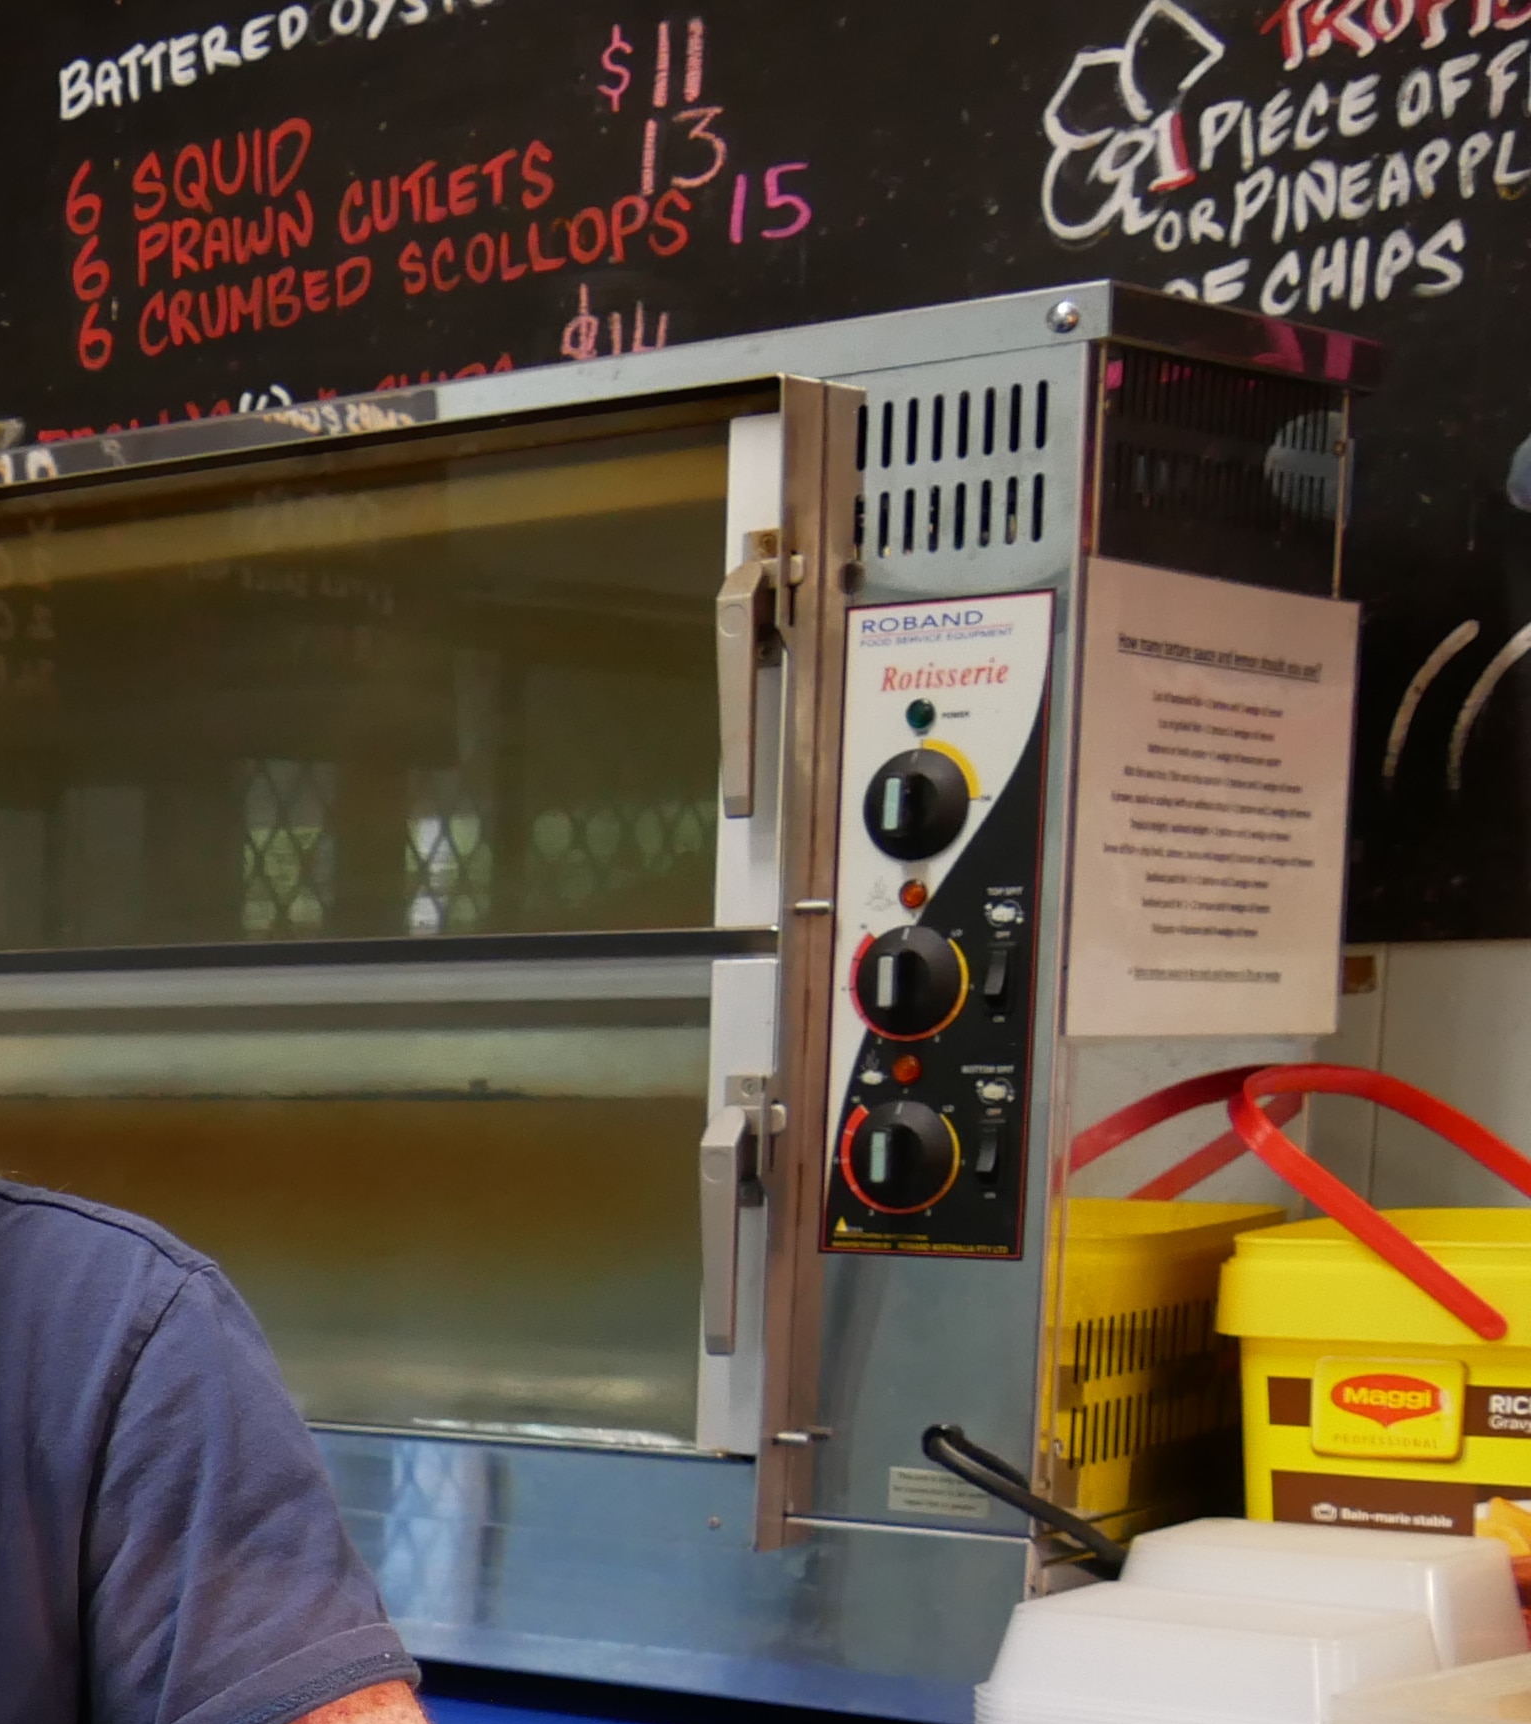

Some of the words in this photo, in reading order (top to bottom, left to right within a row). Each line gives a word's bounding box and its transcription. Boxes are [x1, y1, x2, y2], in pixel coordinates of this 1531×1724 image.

[60, 3, 309, 120] BATTERED
[1198, 73, 1382, 172] PIECE
[1396, 52, 1482, 129] OF
[64, 159, 102, 235] 6
[131, 117, 313, 223] SQUID
[72, 234, 111, 302] 6
[138, 190, 315, 288] PRAWN
[339, 139, 555, 246] CUTLETS
[1153, 198, 1227, 253] OR
[77, 302, 113, 371] 6
[138, 255, 373, 358] CRUMBED
[397, 187, 693, 296] SCOLLOPS
[1259, 217, 1468, 317] CHIPS
[861, 610, 985, 634] ROBAND
[880, 657, 1010, 692] Rotisserie
[1412, 1512, 1454, 1528] stable
